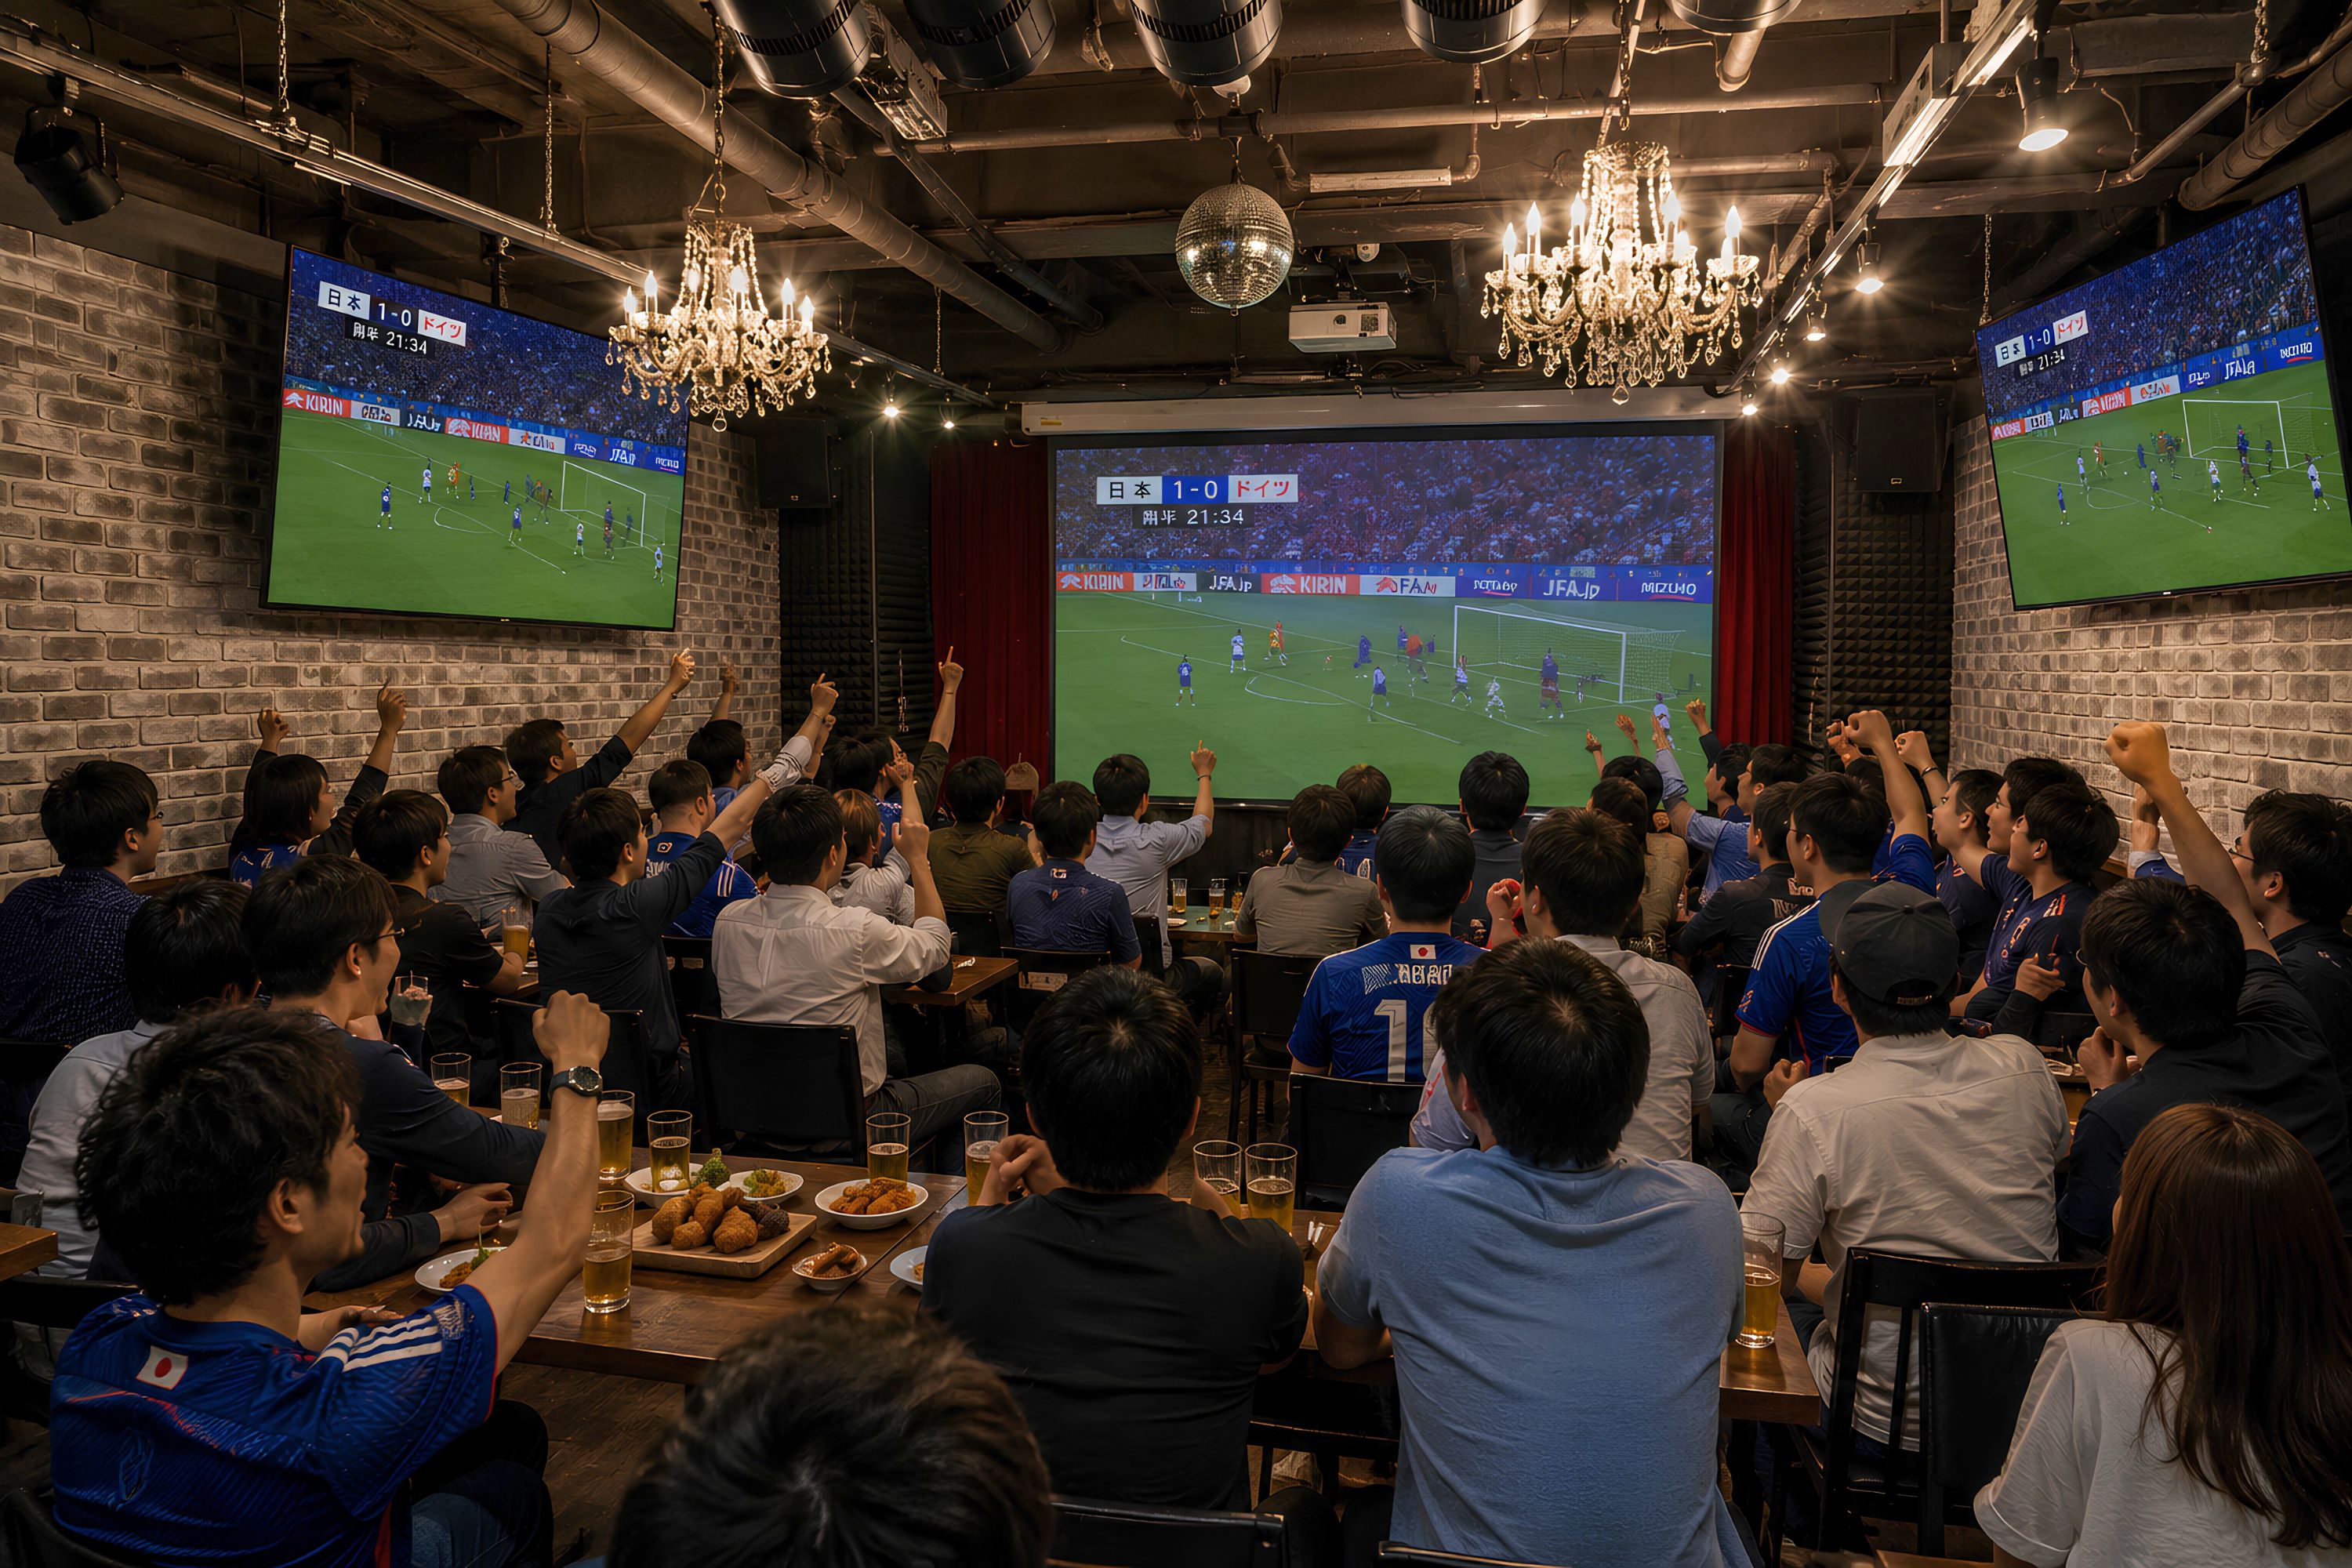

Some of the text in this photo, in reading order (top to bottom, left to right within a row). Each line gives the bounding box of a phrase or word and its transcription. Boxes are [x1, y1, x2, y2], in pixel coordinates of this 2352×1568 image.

[378, 303, 412, 326] 1-0
[423, 316, 462, 339] ドイツ
[386, 331, 427, 354] 21:34
[2029, 328, 2051, 350] 1-0
[305, 394, 343, 416] KIRIN
[1173, 480, 1218, 499] 1-0
[1237, 480, 1290, 498] ドイツ
[1186, 509, 1245, 524] 21:34
[1300, 575, 1347, 593] KIRIN
